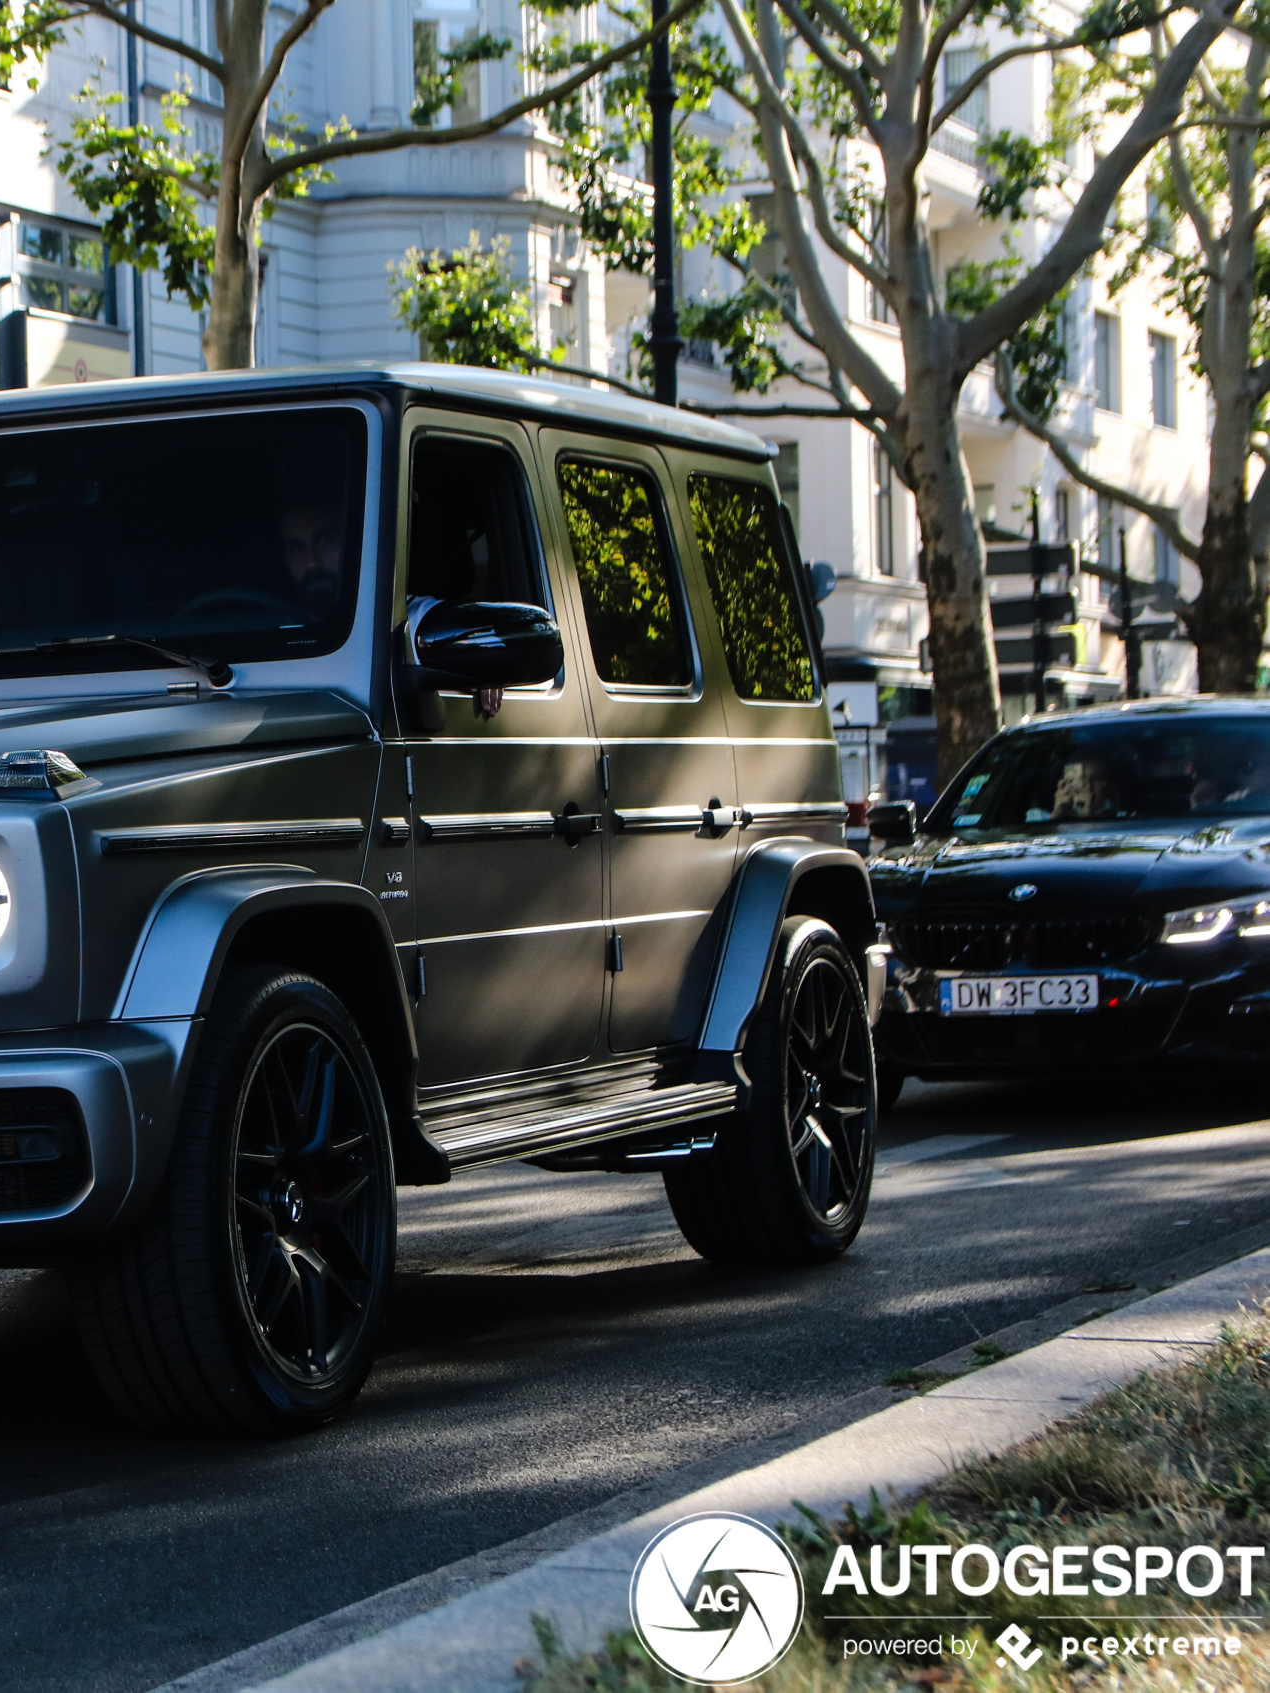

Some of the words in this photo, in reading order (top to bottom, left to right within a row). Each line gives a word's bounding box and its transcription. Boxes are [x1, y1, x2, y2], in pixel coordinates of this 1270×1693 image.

[386, 871, 403, 884] V8
[958, 982, 991, 1008] DW
[1002, 979, 1091, 1007] 3FC33
